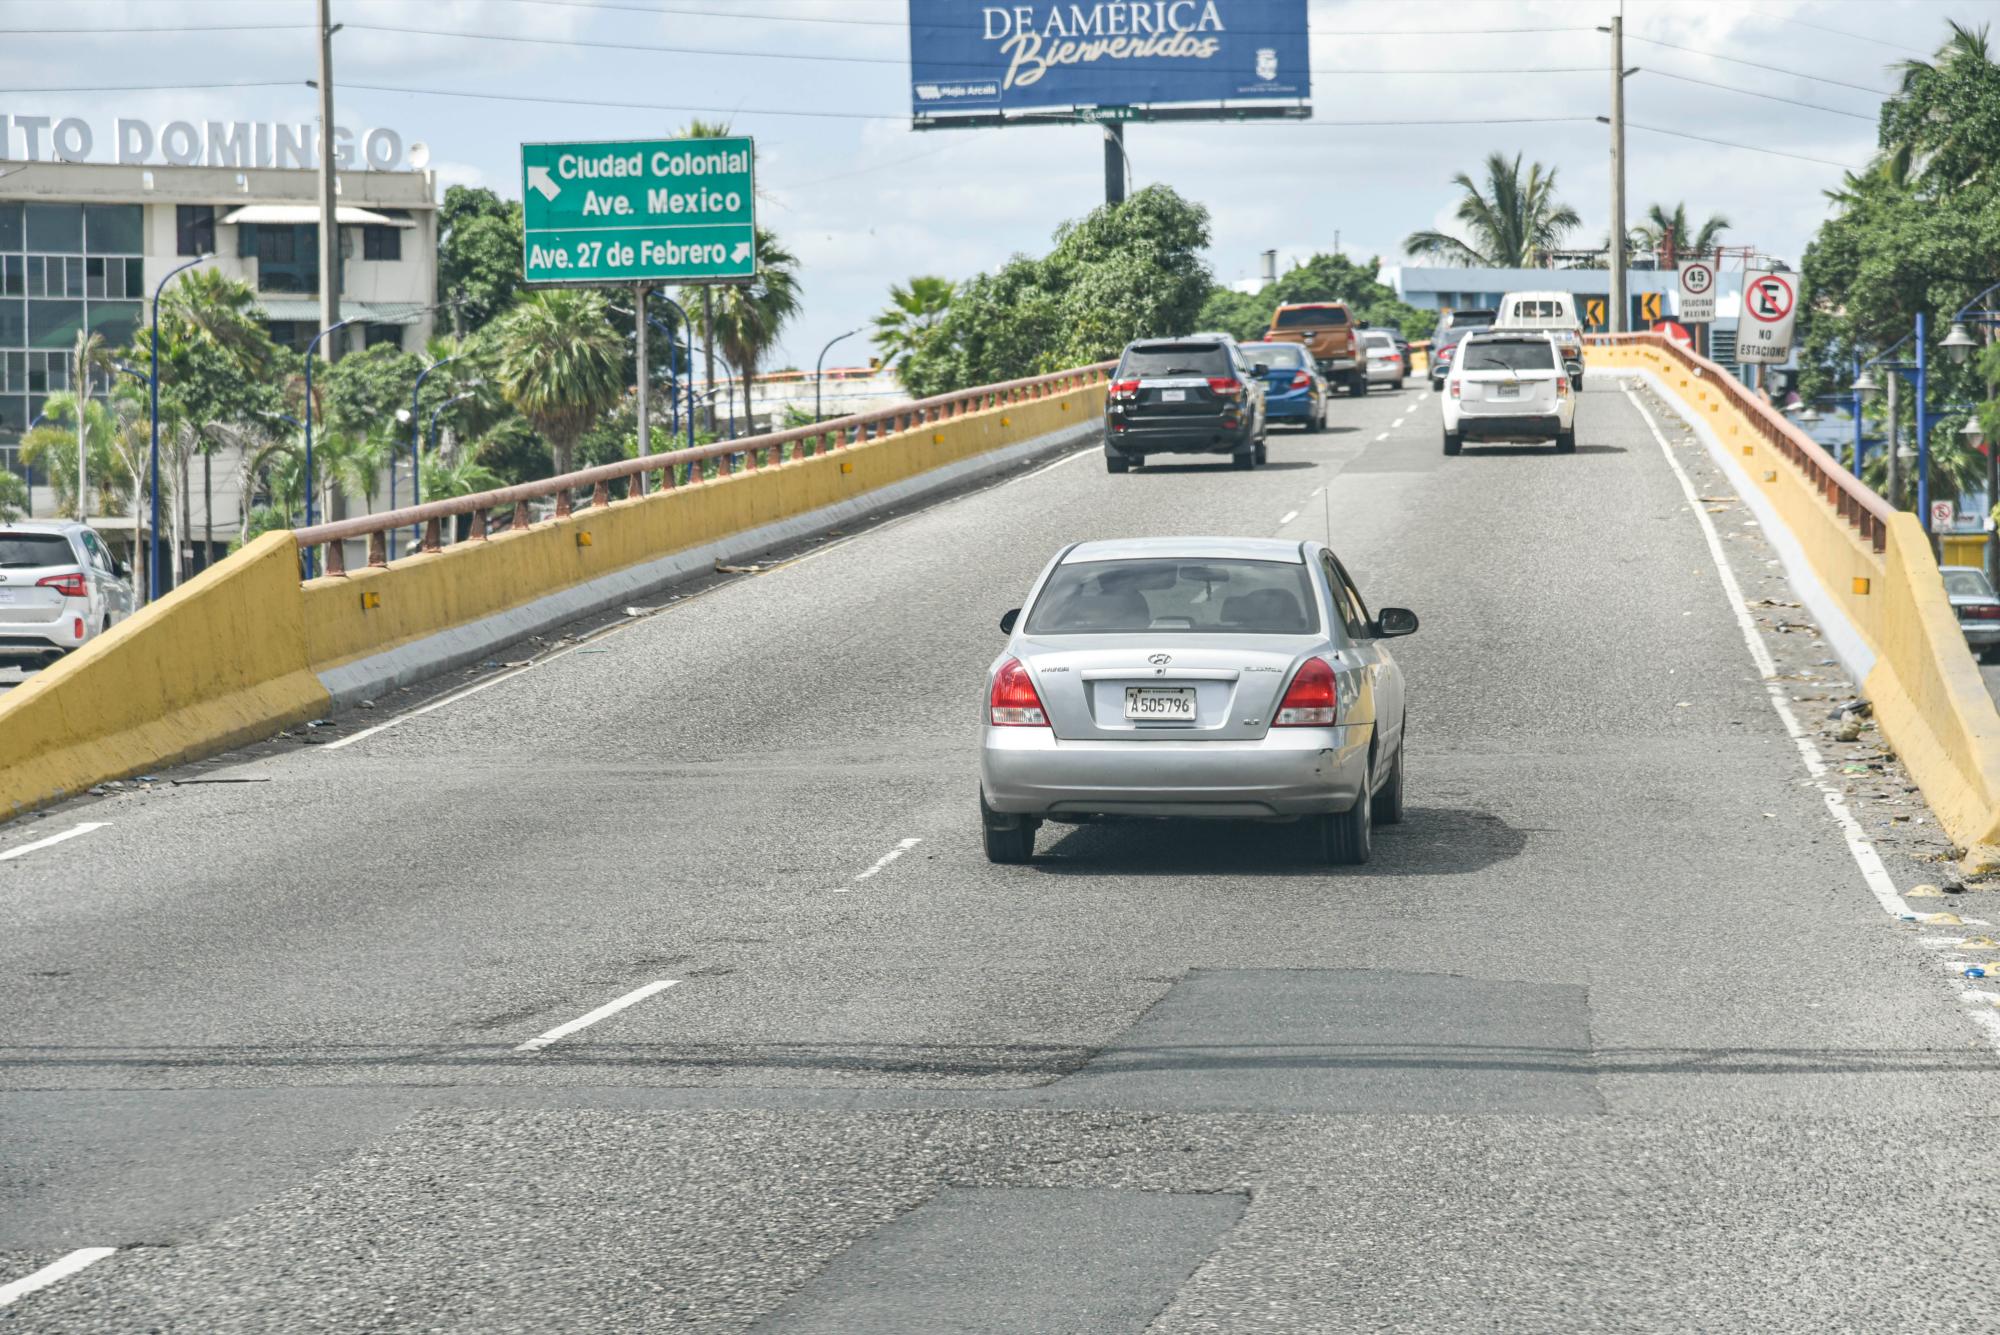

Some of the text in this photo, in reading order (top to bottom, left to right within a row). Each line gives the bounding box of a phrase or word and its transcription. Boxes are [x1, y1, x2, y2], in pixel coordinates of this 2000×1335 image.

[982, 0, 1226, 40] DE AMÉRICA
[1000, 27, 1220, 91] Bienvenidos
[0, 115, 402, 171] TO DOMINGO
[558, 150, 748, 180] Ciudad Colonial
[582, 187, 741, 216] Ave. Mexico
[529, 240, 726, 270] Ave. 27 de Febrero
[1689, 271, 1705, 282] 45
[1681, 299, 1713, 307] VELOCIDAD
[1760, 284, 1779, 314] E
[1684, 310, 1710, 318] MAXIMA
[1758, 330, 1772, 341] NO
[1740, 344, 1786, 358] ESTACIONE
[1131, 698, 1190, 713] A505796
